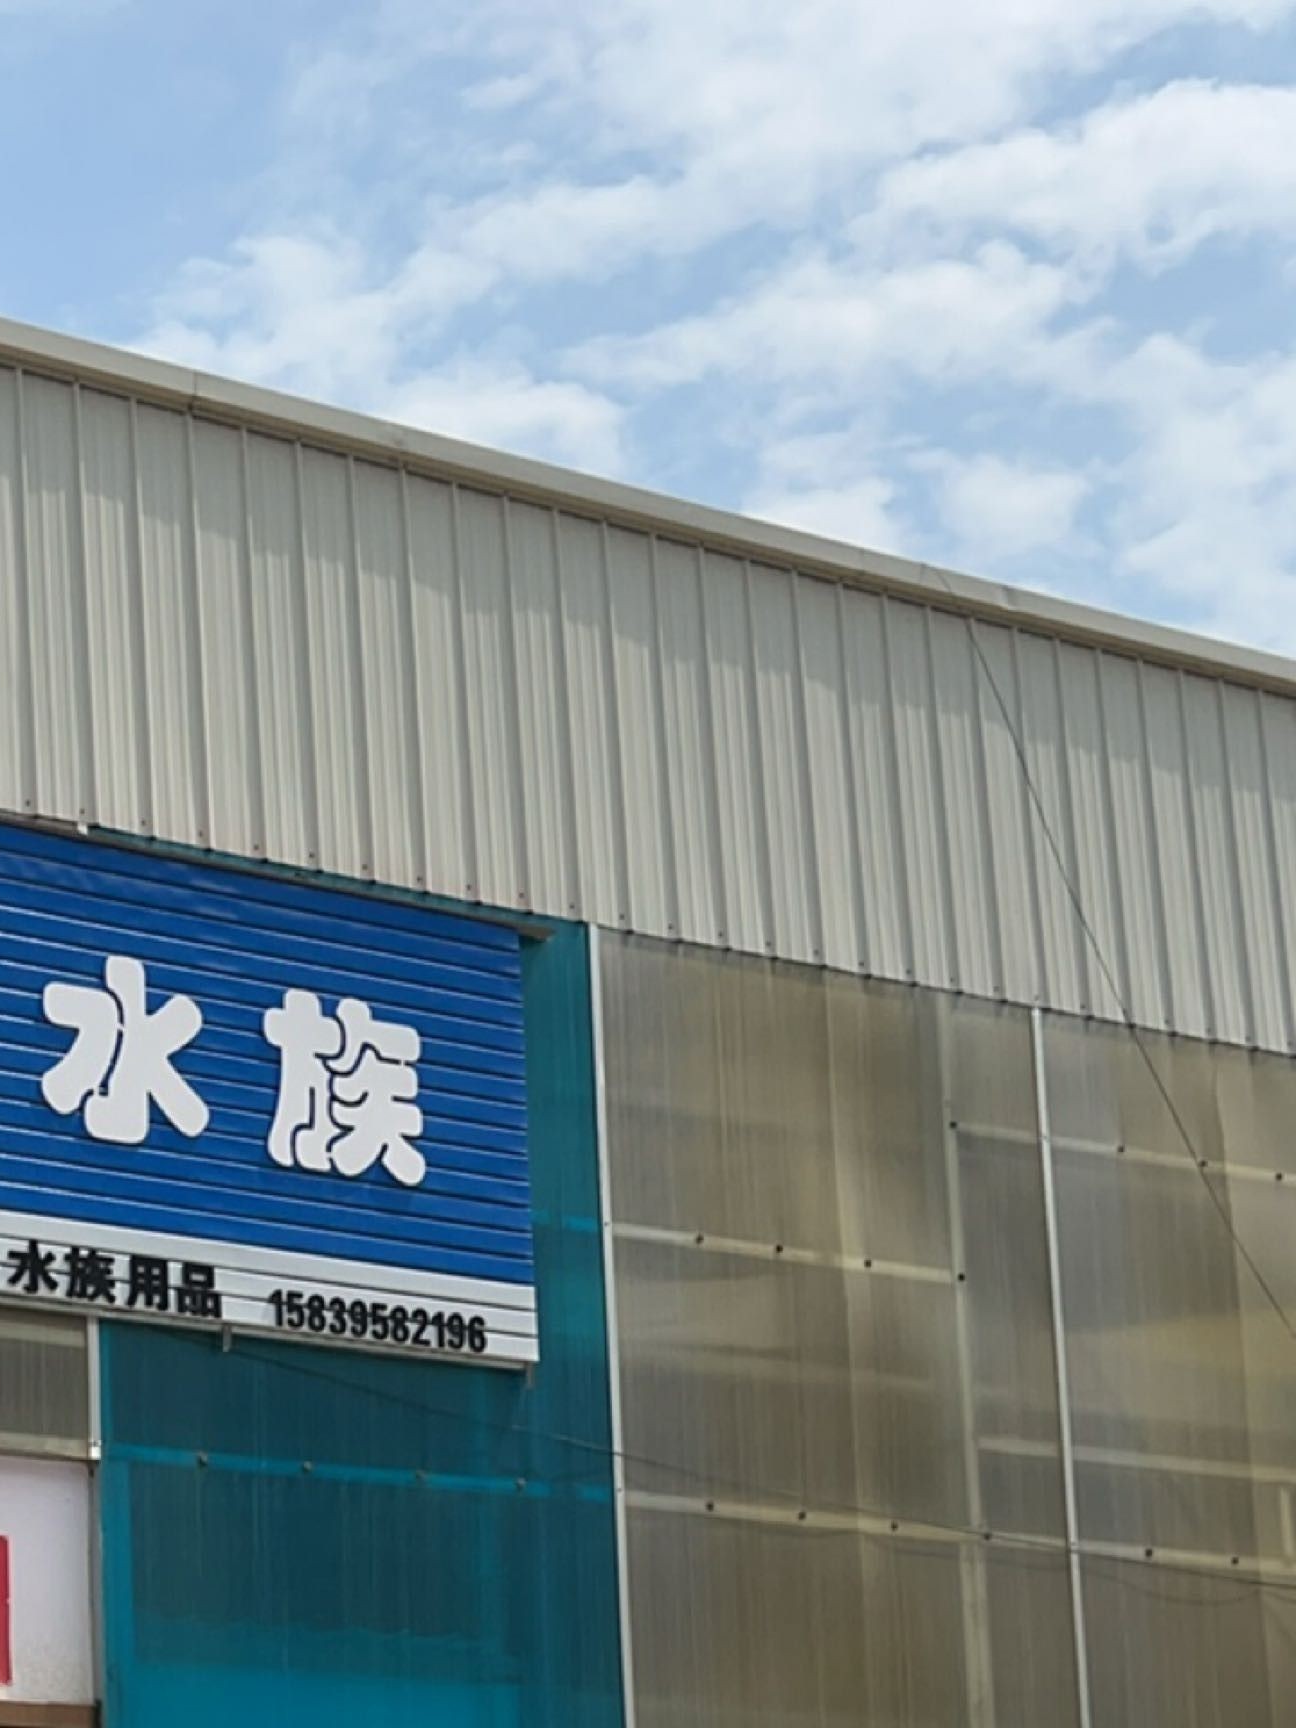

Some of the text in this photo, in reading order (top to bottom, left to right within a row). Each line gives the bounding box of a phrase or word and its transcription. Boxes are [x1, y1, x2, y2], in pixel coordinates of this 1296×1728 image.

[7, 1239, 223, 1319] 水族用品
[268, 1289, 488, 1354] 15839582196
